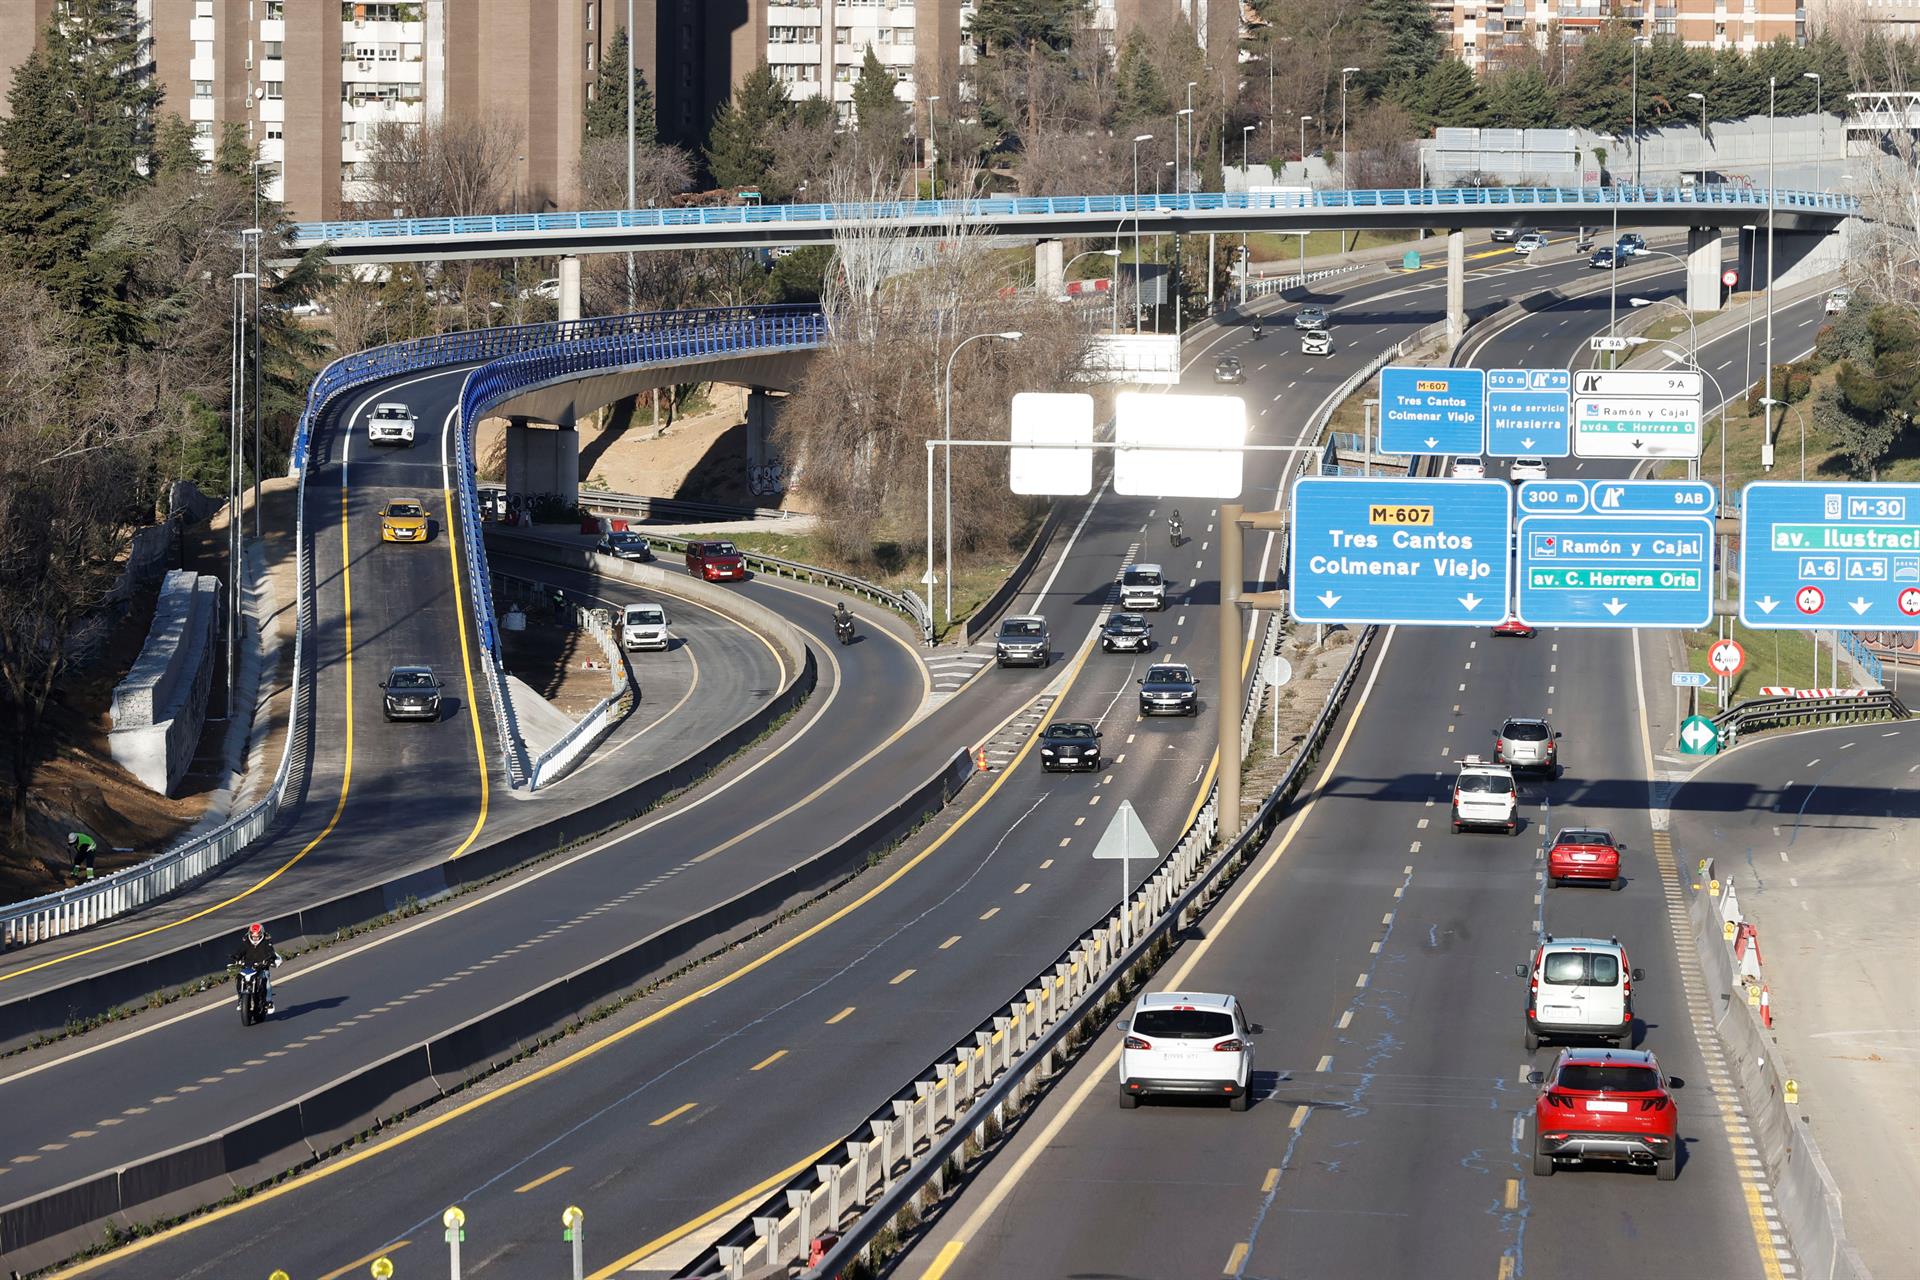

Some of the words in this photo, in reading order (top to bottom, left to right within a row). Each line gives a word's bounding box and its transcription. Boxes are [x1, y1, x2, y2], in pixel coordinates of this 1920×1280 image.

[1418, 382, 1447, 391] M-607
[1491, 375, 1514, 384] 500
[1396, 395, 1422, 406] Tres
[1426, 396, 1467, 407] Cantos
[1510, 404, 1522, 412] de
[1525, 404, 1565, 413] servicio
[1603, 407, 1642, 416] Ramón
[1647, 410, 1654, 418] y
[1660, 407, 1690, 419] Cajal
[1387, 410, 1442, 421] Colmenar
[1447, 411, 1476, 424] Viejo
[1495, 418, 1561, 430] Mirasierra
[1632, 422, 1679, 433] Herrera
[1529, 491, 1558, 503] 300
[1565, 493, 1578, 503] m
[1674, 492, 1704, 504] 9AB
[1852, 500, 1901, 516] M-30
[1372, 508, 1431, 523] M-607
[1328, 529, 1378, 548] Tres
[1392, 530, 1473, 549] Cantos
[1776, 532, 1811, 547] av.
[1562, 540, 1621, 554] Ramón
[1631, 543, 1641, 556] y
[1652, 540, 1699, 557] Cajal
[1309, 555, 1421, 575] Colmenar
[1433, 558, 1491, 580] Viejo
[1803, 561, 1836, 577] A-6
[1850, 561, 1884, 577] A-5
[1533, 574, 1560, 586] av.
[1564, 571, 1585, 586] C.
[1589, 572, 1654, 587] Herrera
[1659, 572, 1697, 587] Oria
